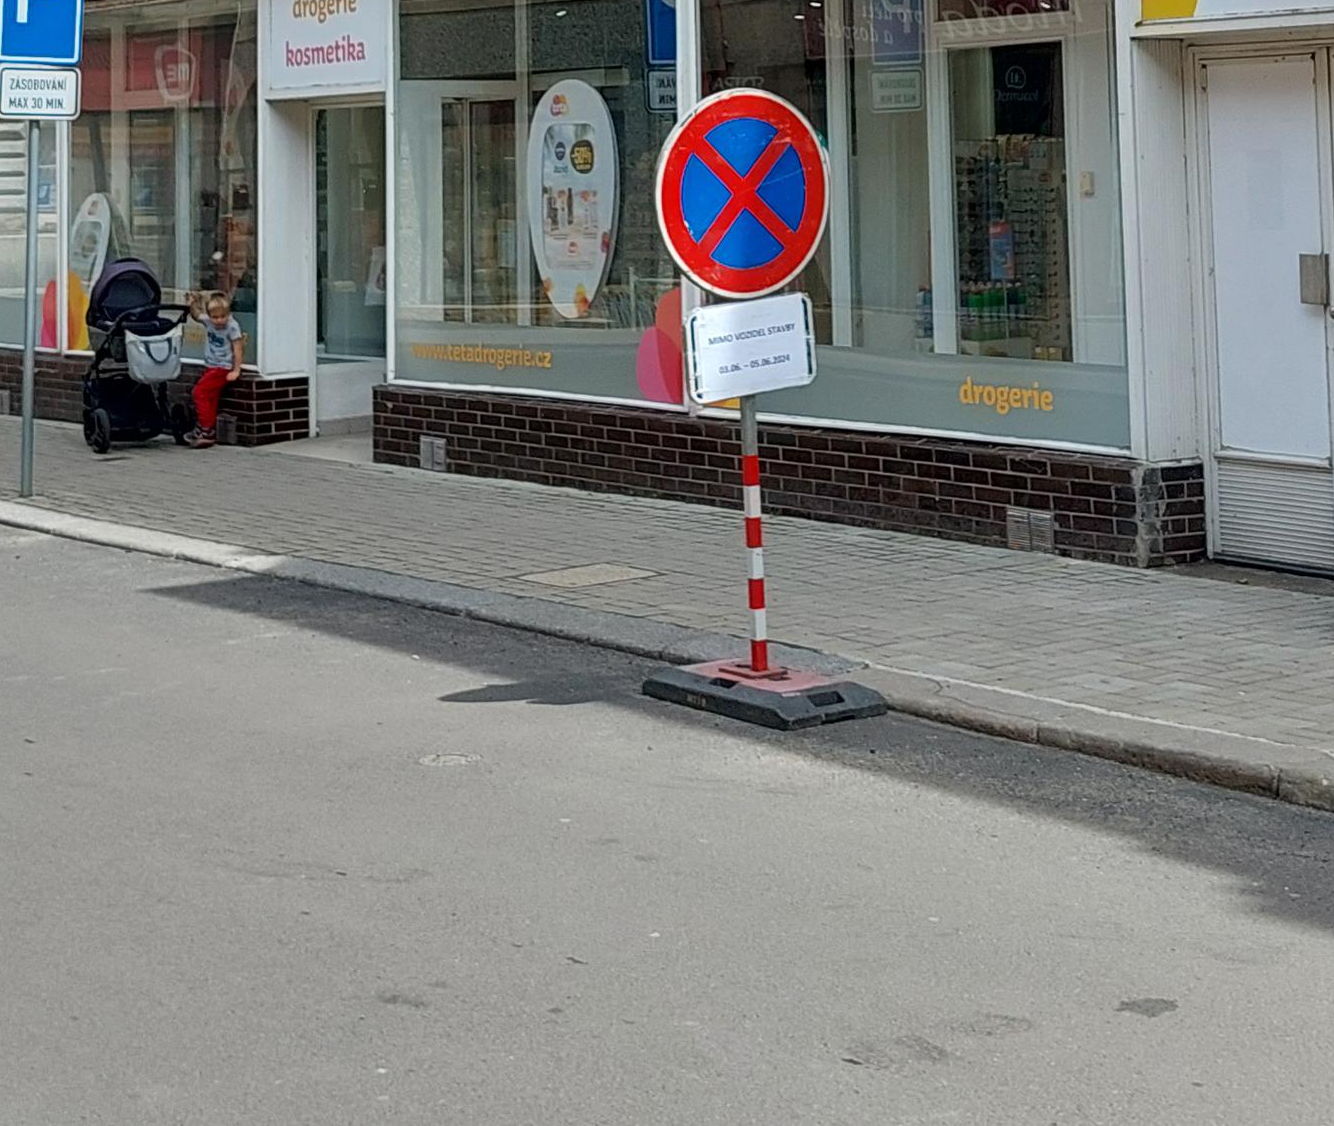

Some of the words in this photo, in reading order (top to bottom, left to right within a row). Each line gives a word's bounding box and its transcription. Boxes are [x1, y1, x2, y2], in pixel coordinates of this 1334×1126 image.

[285, 34, 366, 67] kosmetika
[9, 75, 67, 91] ZÁSOBOVÁNÍ
[9, 97, 28, 109] MAX
[31, 97, 43, 109] 30
[46, 97, 66, 109] MIN.
[708, 334, 734, 346] MIMO
[959, 376, 1054, 415] drogerie
